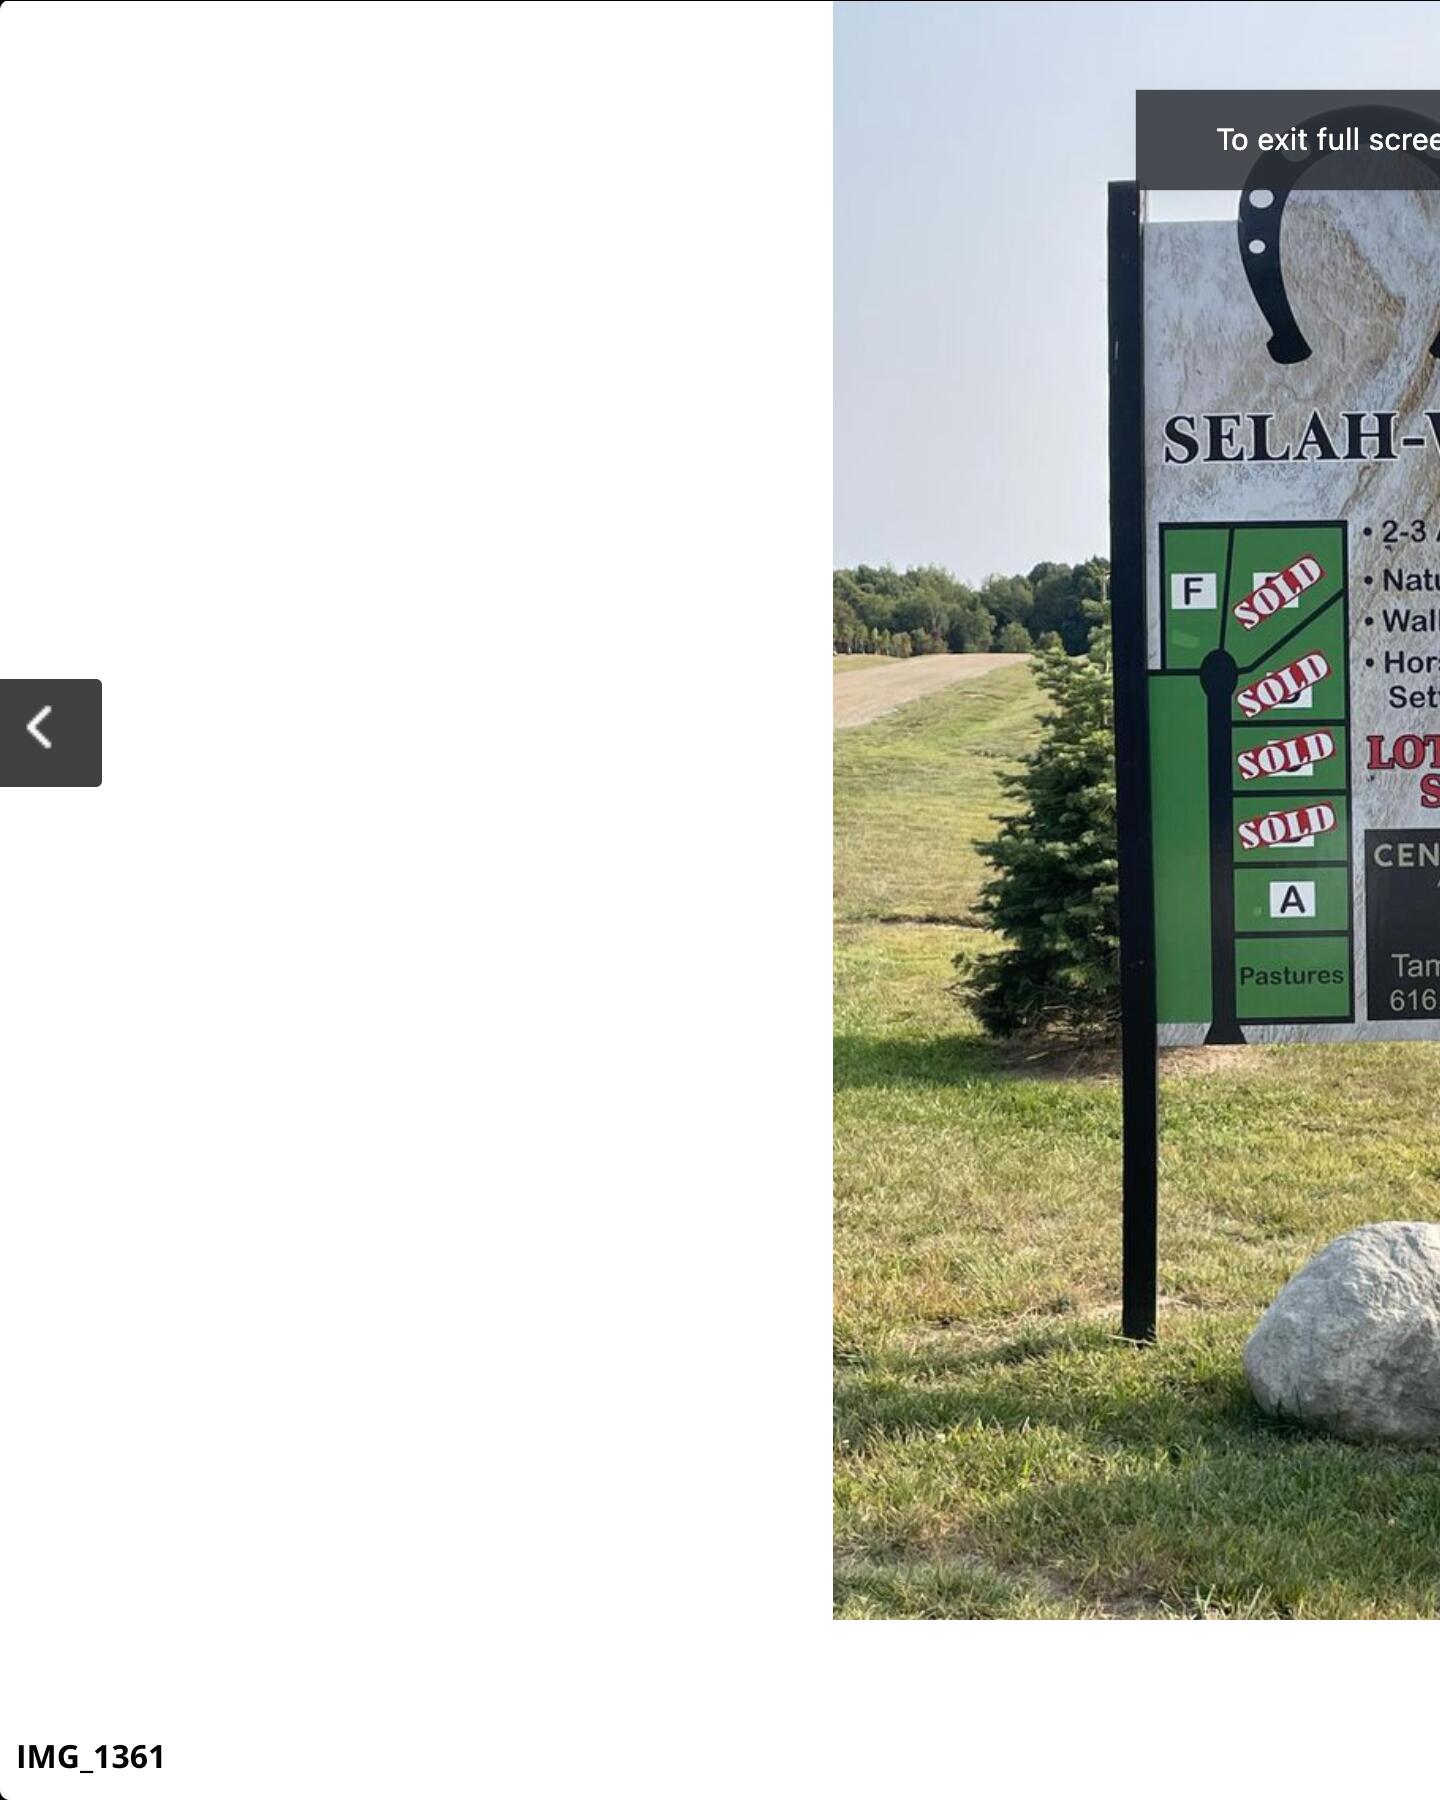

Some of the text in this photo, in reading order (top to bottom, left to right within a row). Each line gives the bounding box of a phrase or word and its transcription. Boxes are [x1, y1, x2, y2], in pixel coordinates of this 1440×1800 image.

[1382, 519, 1427, 544] 2-3
[1183, 576, 1204, 606] F
[1233, 556, 1323, 631] SOLD
[1236, 652, 1330, 718] SOLD
[1237, 731, 1335, 780] SOLD
[1238, 804, 1336, 849] SOLD
[1279, 884, 1306, 914] A
[1239, 965, 1345, 986] Pastures
